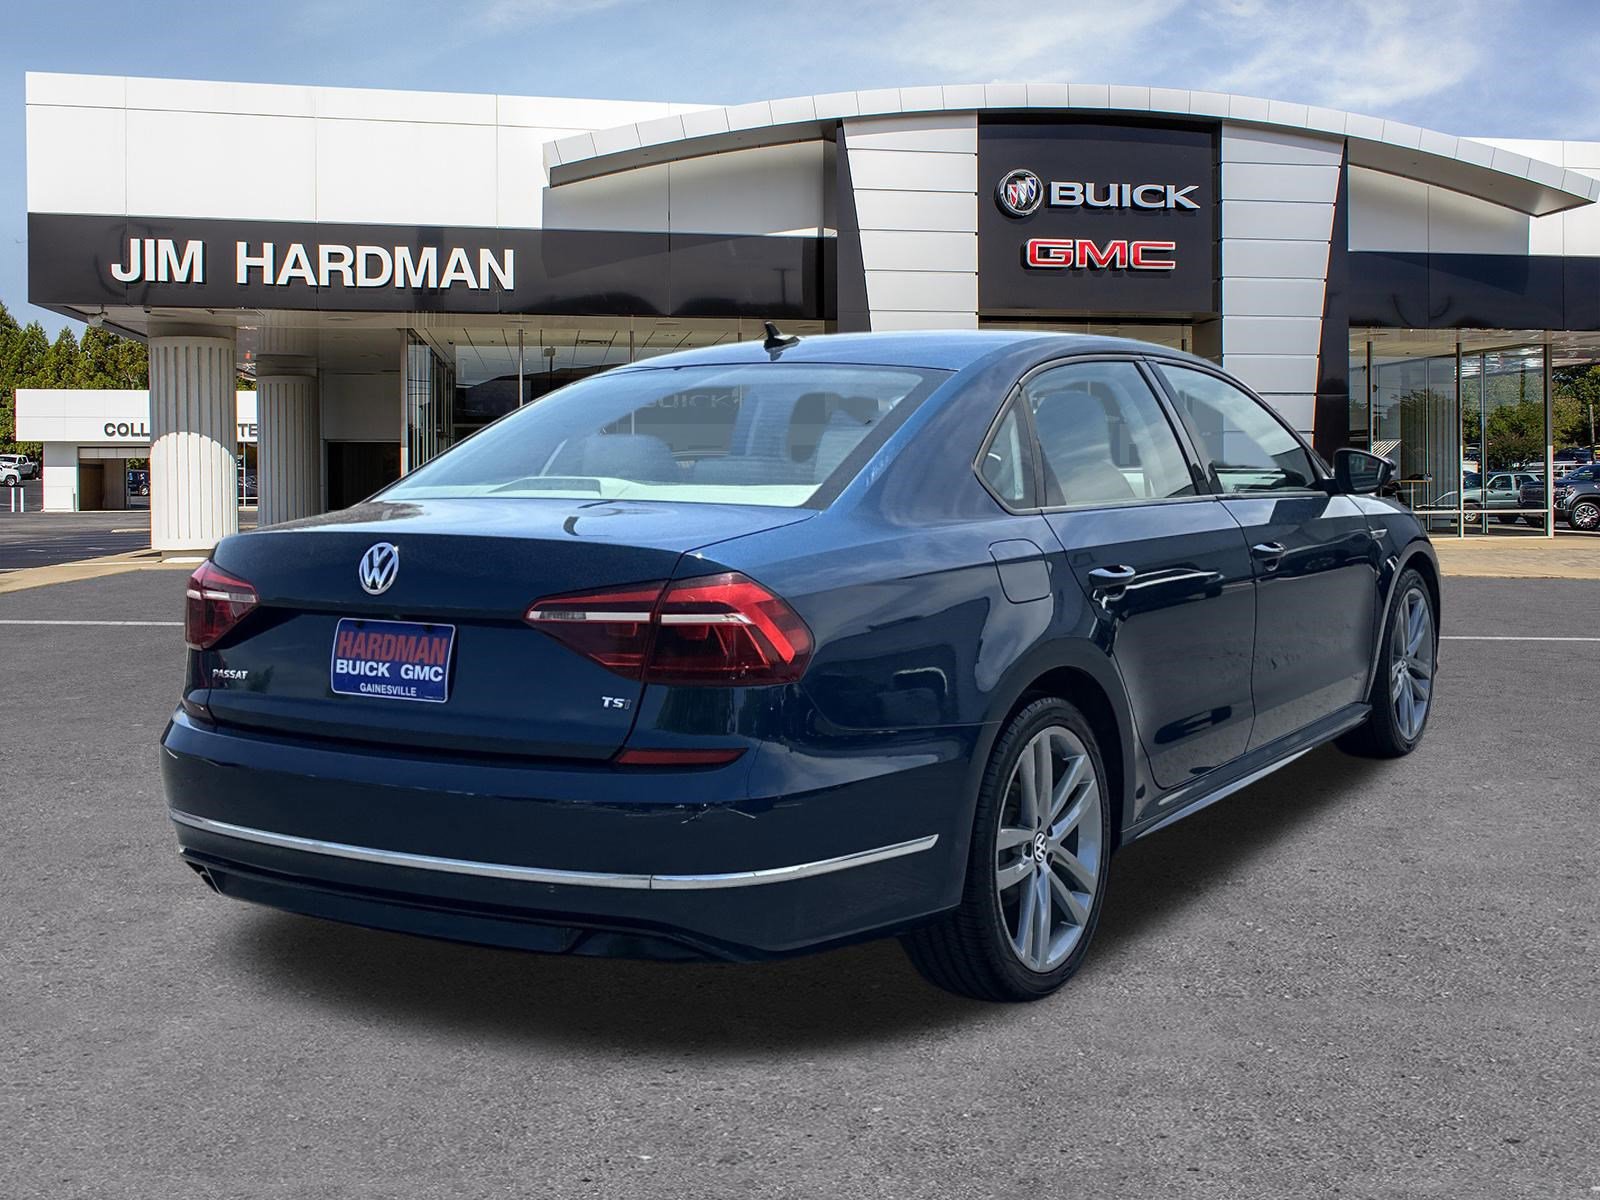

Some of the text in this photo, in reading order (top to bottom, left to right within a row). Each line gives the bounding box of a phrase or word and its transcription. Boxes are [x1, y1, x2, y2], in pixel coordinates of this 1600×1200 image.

[1051, 181, 1200, 209] BUICK
[111, 238, 515, 290] JIM HARDMAN
[1026, 238, 1176, 269] GMC
[336, 631, 448, 665] HARDMAN
[212, 668, 249, 680] PASSAT
[335, 659, 444, 682] BUICK GMC
[359, 682, 417, 697] GAINESVILLE
